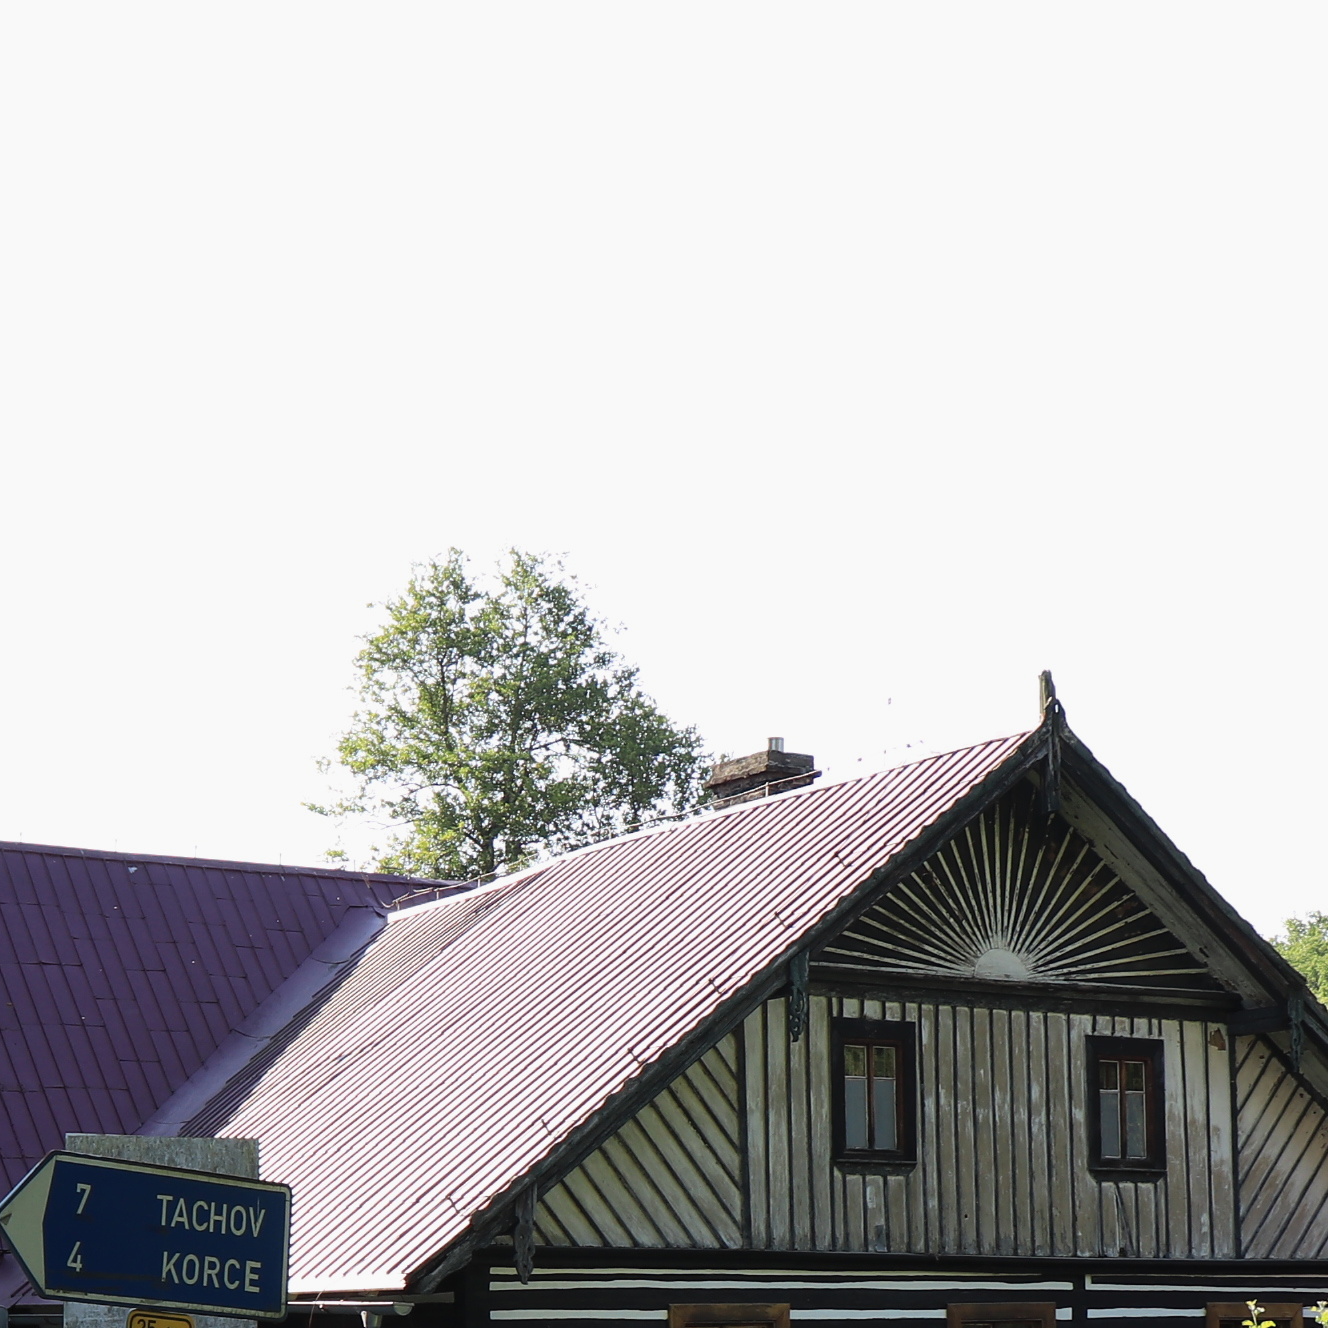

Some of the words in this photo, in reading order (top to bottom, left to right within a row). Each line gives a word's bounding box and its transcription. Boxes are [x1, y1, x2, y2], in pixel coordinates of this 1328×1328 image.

[76, 1183, 91, 1214] 7
[157, 1194, 266, 1238] TACHOV
[66, 1241, 83, 1272] 4
[161, 1251, 262, 1293] KORCE
